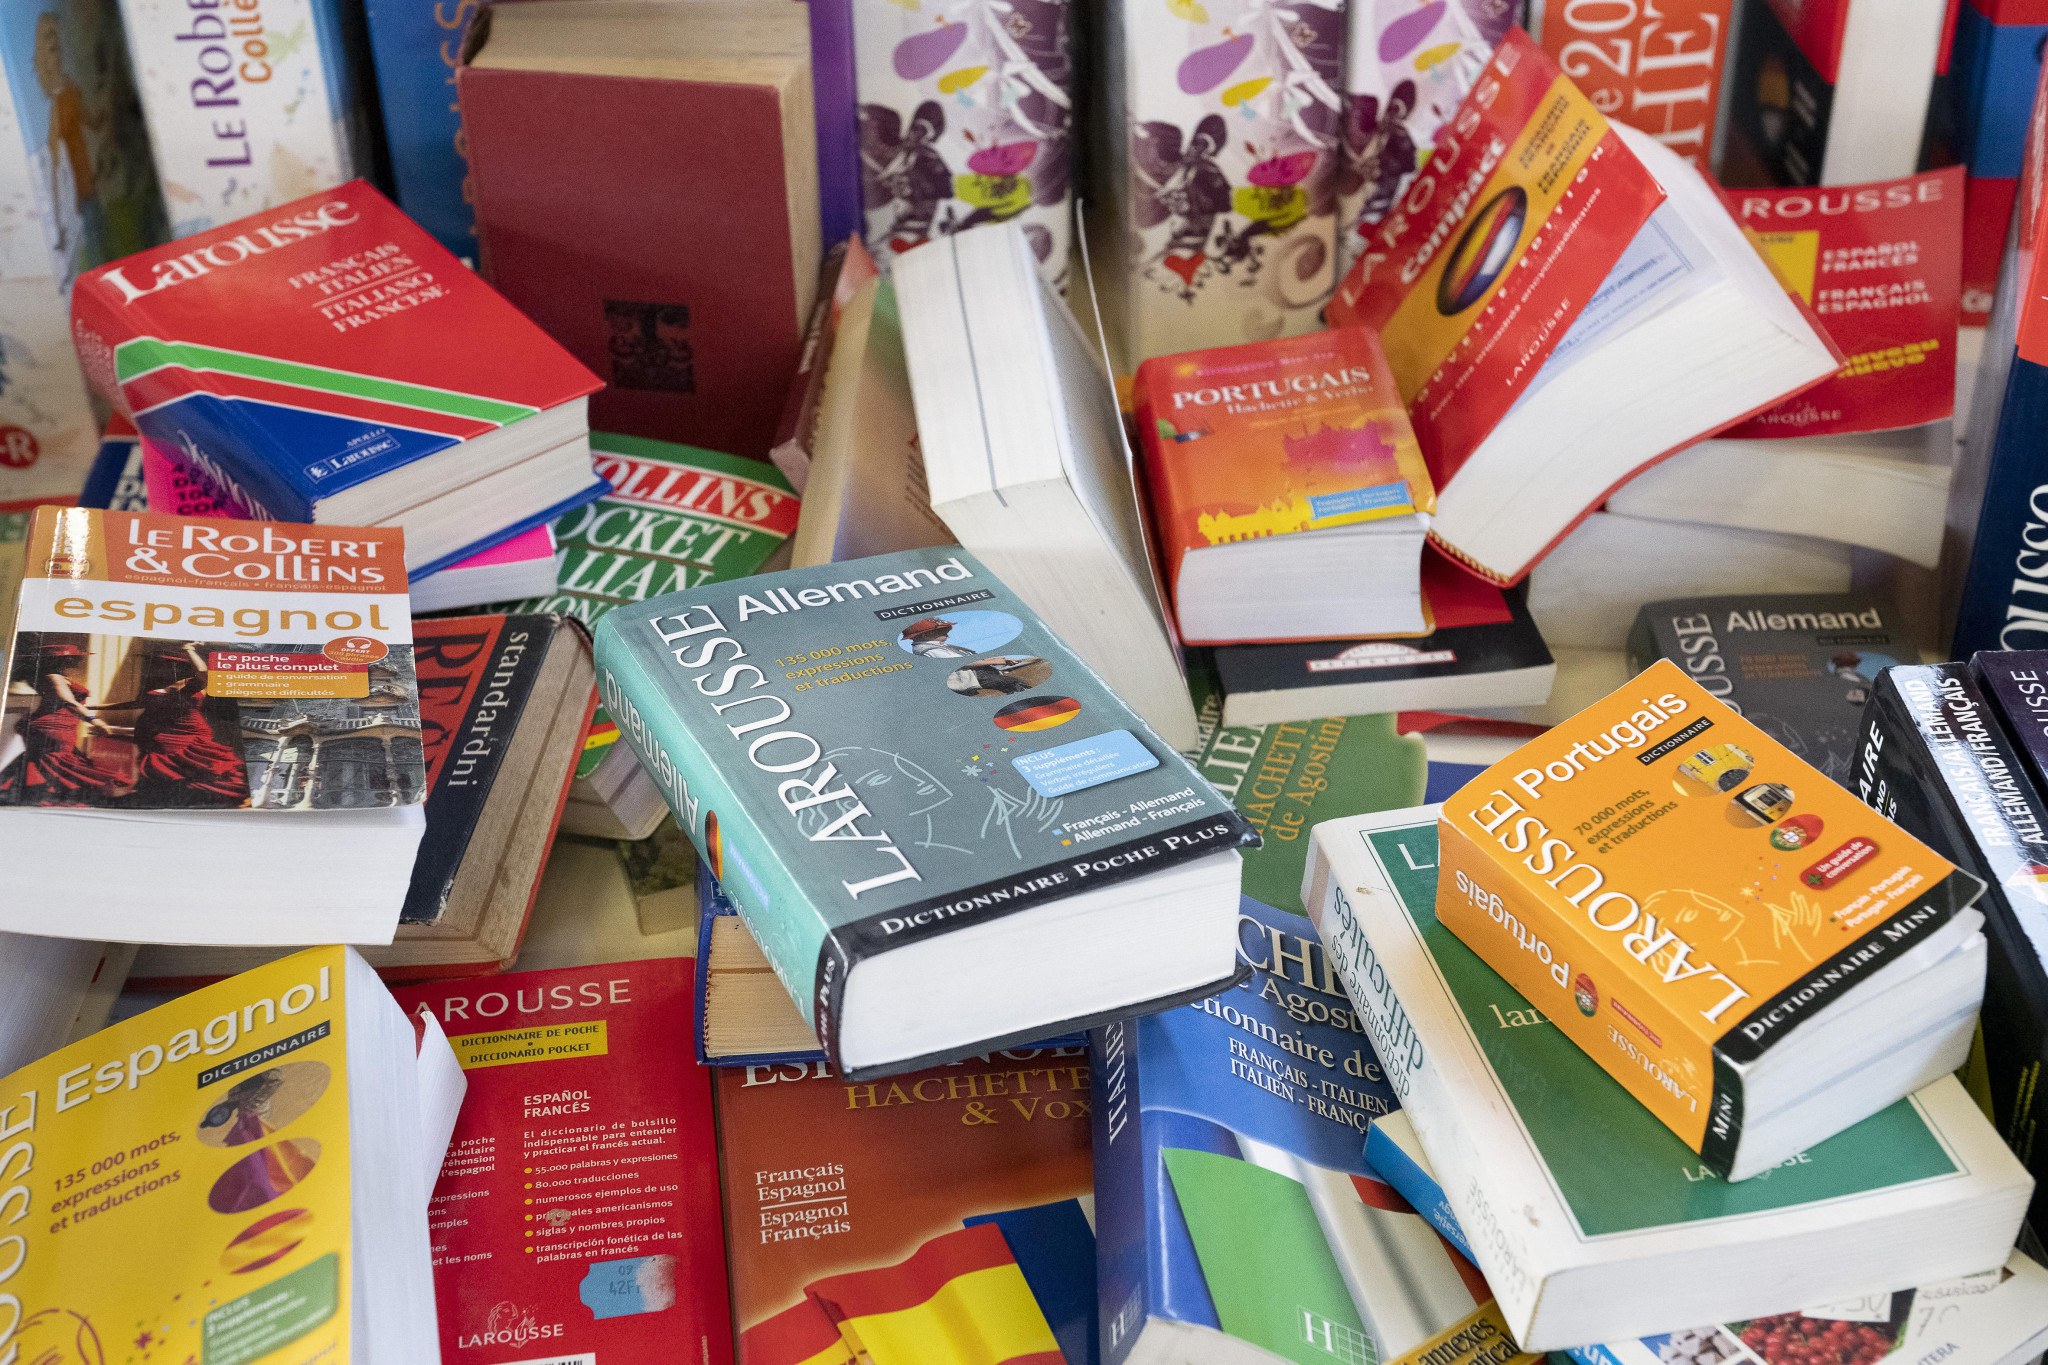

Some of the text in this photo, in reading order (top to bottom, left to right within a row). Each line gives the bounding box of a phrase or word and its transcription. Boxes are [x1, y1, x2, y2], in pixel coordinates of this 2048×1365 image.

[206, 118, 252, 168] LE
[1742, 179, 1945, 218] ROUSSE
[1172, 366, 1371, 410] PORTUGAIS
[590, 455, 783, 522] OLLINS
[552, 500, 751, 566] OCKET
[126, 547, 171, 574] &
[738, 557, 974, 621] Allemand
[879, 590, 991, 620] DICTIONNAIRE
[53, 597, 389, 637] espagnol
[1726, 608, 1882, 634] Allemand
[217, 652, 290, 664] Le poche
[217, 662, 339, 672] le plus complet
[775, 636, 895, 668] 135 000 mots,
[785, 651, 885, 681] expressions
[225, 673, 258, 681] guide
[795, 660, 914, 693] et traductions
[605, 667, 700, 836] Allemand
[649, 604, 922, 901] LAROUSSE
[1512, 692, 1690, 800] Portugais
[1640, 718, 1711, 765] DICTIONNAIRE
[1015, 750, 1056, 766] INCLUS
[1021, 765, 1032, 774] 3
[1938, 677, 2047, 848] ALLEMAND/FRANÇAIS
[1040, 774, 1072, 787] Verbes
[1047, 782, 1075, 794] Guide
[1088, 759, 1155, 783] communication
[1062, 786, 1197, 835] Français Allemand
[1073, 797, 1206, 844] Allemand Français
[1573, 787, 1651, 837] 70 000 mots,
[1586, 799, 1655, 845] expressions
[1597, 799, 1679, 854] et traductions
[1269, 812, 1305, 842] de
[878, 822, 1230, 936] DICTIONNAIRE POCHE PLUS
[1468, 789, 1751, 1024] LAROUSSE
[1455, 868, 1571, 990] Portugais
[1335, 885, 1425, 1075] difficultés
[1743, 940, 1885, 1043] DICTIONNAIRE
[1882, 904, 1938, 942] MINI
[414, 978, 632, 1022] AROUSSE
[55, 966, 332, 1115] Espagnol
[461, 1024, 600, 1047] DICTIONNAIRE DE POCHE
[1191, 994, 1382, 1082] tionnaire de
[201, 1024, 329, 1086] DICTIONNAIRE
[470, 1042, 592, 1064] DICCIONARIO POCKET
[1606, 1023, 1698, 1113] LAROUSSE
[843, 1065, 1091, 1110] HACHETTE
[1228, 1036, 1390, 1116] FRANÇAIS ITALIEN
[1230, 1057, 1295, 1104] ITALIEN
[523, 1089, 592, 1106] ESPAÑOL
[523, 1101, 591, 1119] FRANCÉS
[961, 1101, 999, 1126] &
[461, 1136, 496, 1147] poche
[523, 1116, 677, 1139] El diccionario de bolsillo
[523, 1126, 678, 1149] indispensable para entender
[54, 1130, 182, 1192] 135 000 mots,
[445, 1146, 496, 1158] cabulaire
[523, 1136, 667, 1159] y practicar el francés actual.
[535, 1151, 679, 1175] 55.000 palabras y expresiones
[50, 1156, 161, 1214] expressions
[535, 1170, 640, 1189] 80.000 traducciones
[755, 1161, 845, 1187] Français
[757, 1177, 847, 1202] Espagnol
[49, 1166, 182, 1235] et traductions
[535, 1183, 679, 1205] numerosos ejemplos de uso
[595, 1199, 673, 1216] americanismos
[535, 1215, 666, 1237] siglas y nombres propios
[759, 1201, 850, 1228] Espagnol
[535, 1230, 683, 1254] transcripción fonética de las
[760, 1219, 852, 1245] Français
[445, 1255, 461, 1264] les
[463, 1251, 493, 1262] noms
[536, 1243, 640, 1264] palabras en francés
[458, 1323, 565, 1349] LAROUSSE
